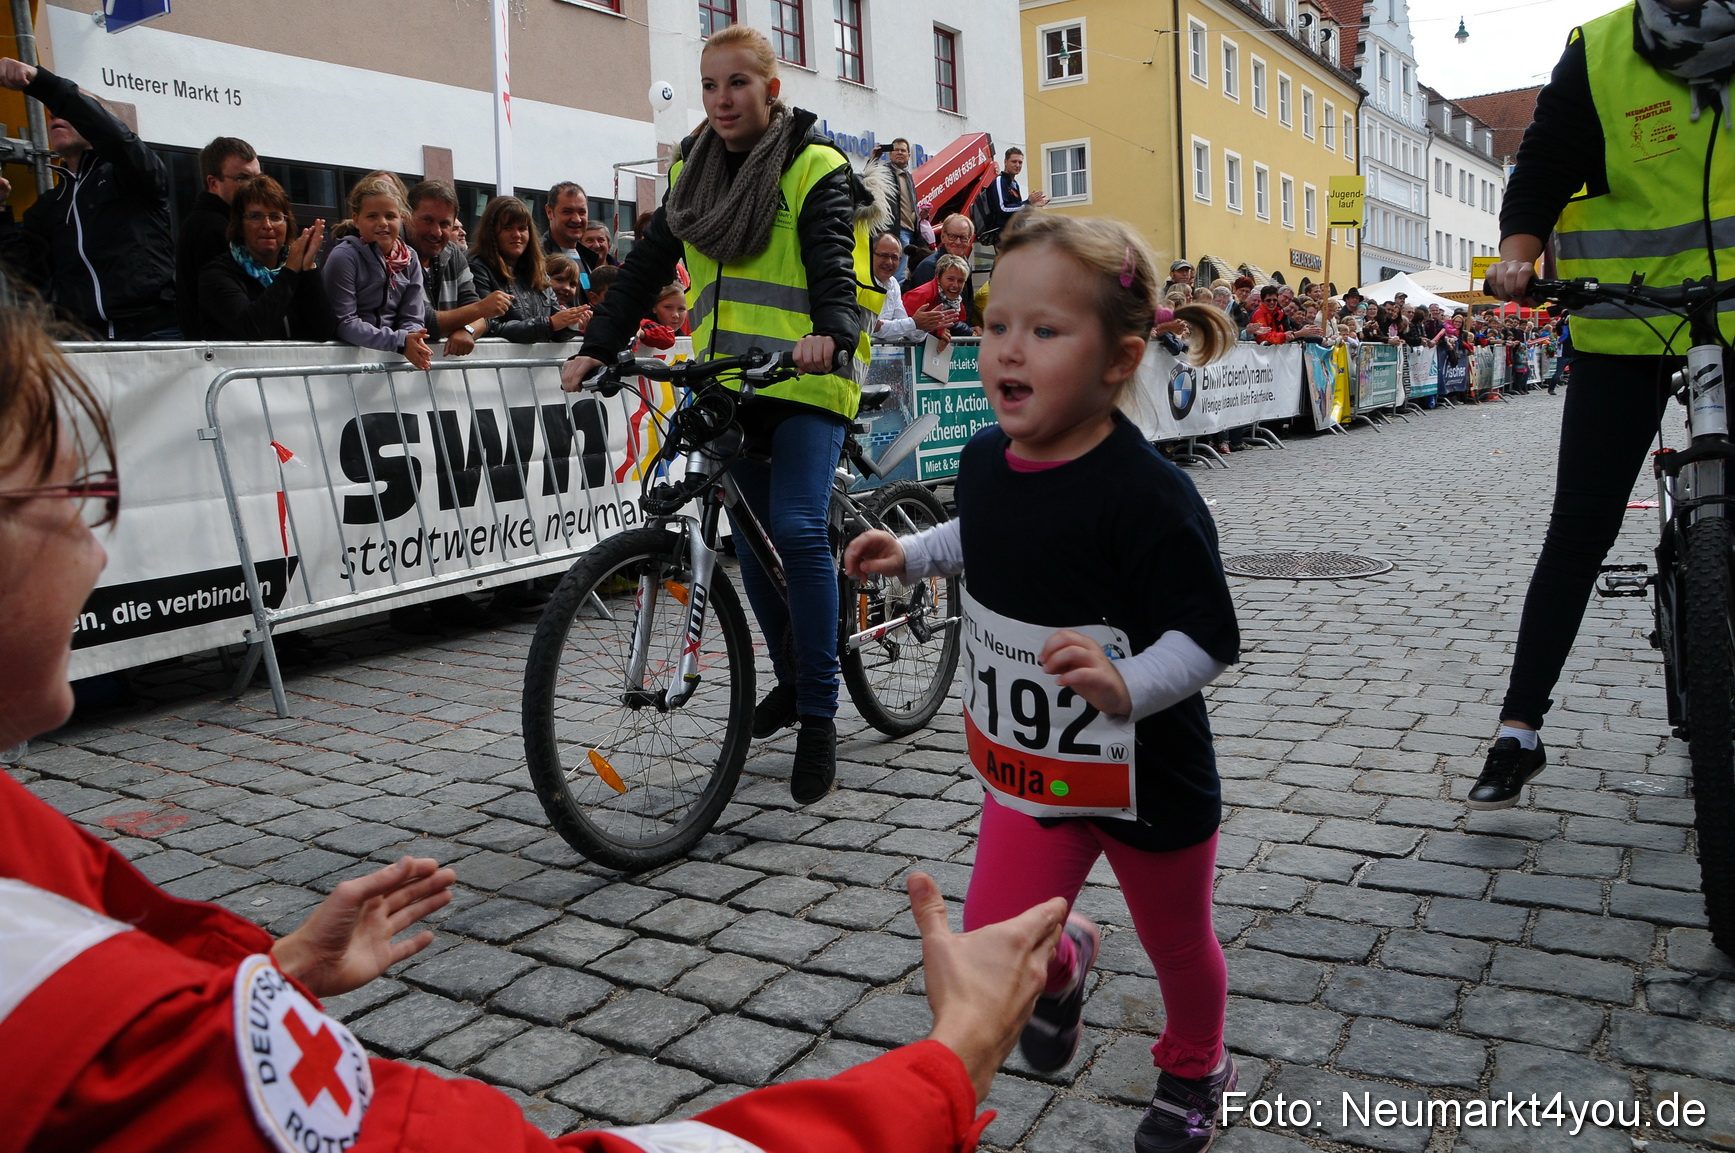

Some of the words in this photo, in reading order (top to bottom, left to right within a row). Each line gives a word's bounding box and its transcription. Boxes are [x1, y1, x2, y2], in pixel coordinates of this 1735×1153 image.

[102, 67, 168, 95] Unterer
[173, 79, 219, 104] Markt
[224, 88, 242, 106] 15
[1625, 100, 1671, 117] NEUMARKTER
[1635, 106, 1672, 122] STADTLAUF
[961, 156, 976, 175] 6352
[1330, 190, 1364, 200] Jugend-
[1338, 200, 1355, 208] lauf
[921, 395, 941, 415] Fun
[944, 395, 953, 413] &
[956, 392, 988, 413] Action
[925, 459, 942, 473] Miet
[942, 458, 949, 471] &
[340, 513, 536, 580] stadtwerke
[112, 600, 152, 625] die
[1110, 746, 1125, 760] W
[986, 750, 1044, 796] Anja
